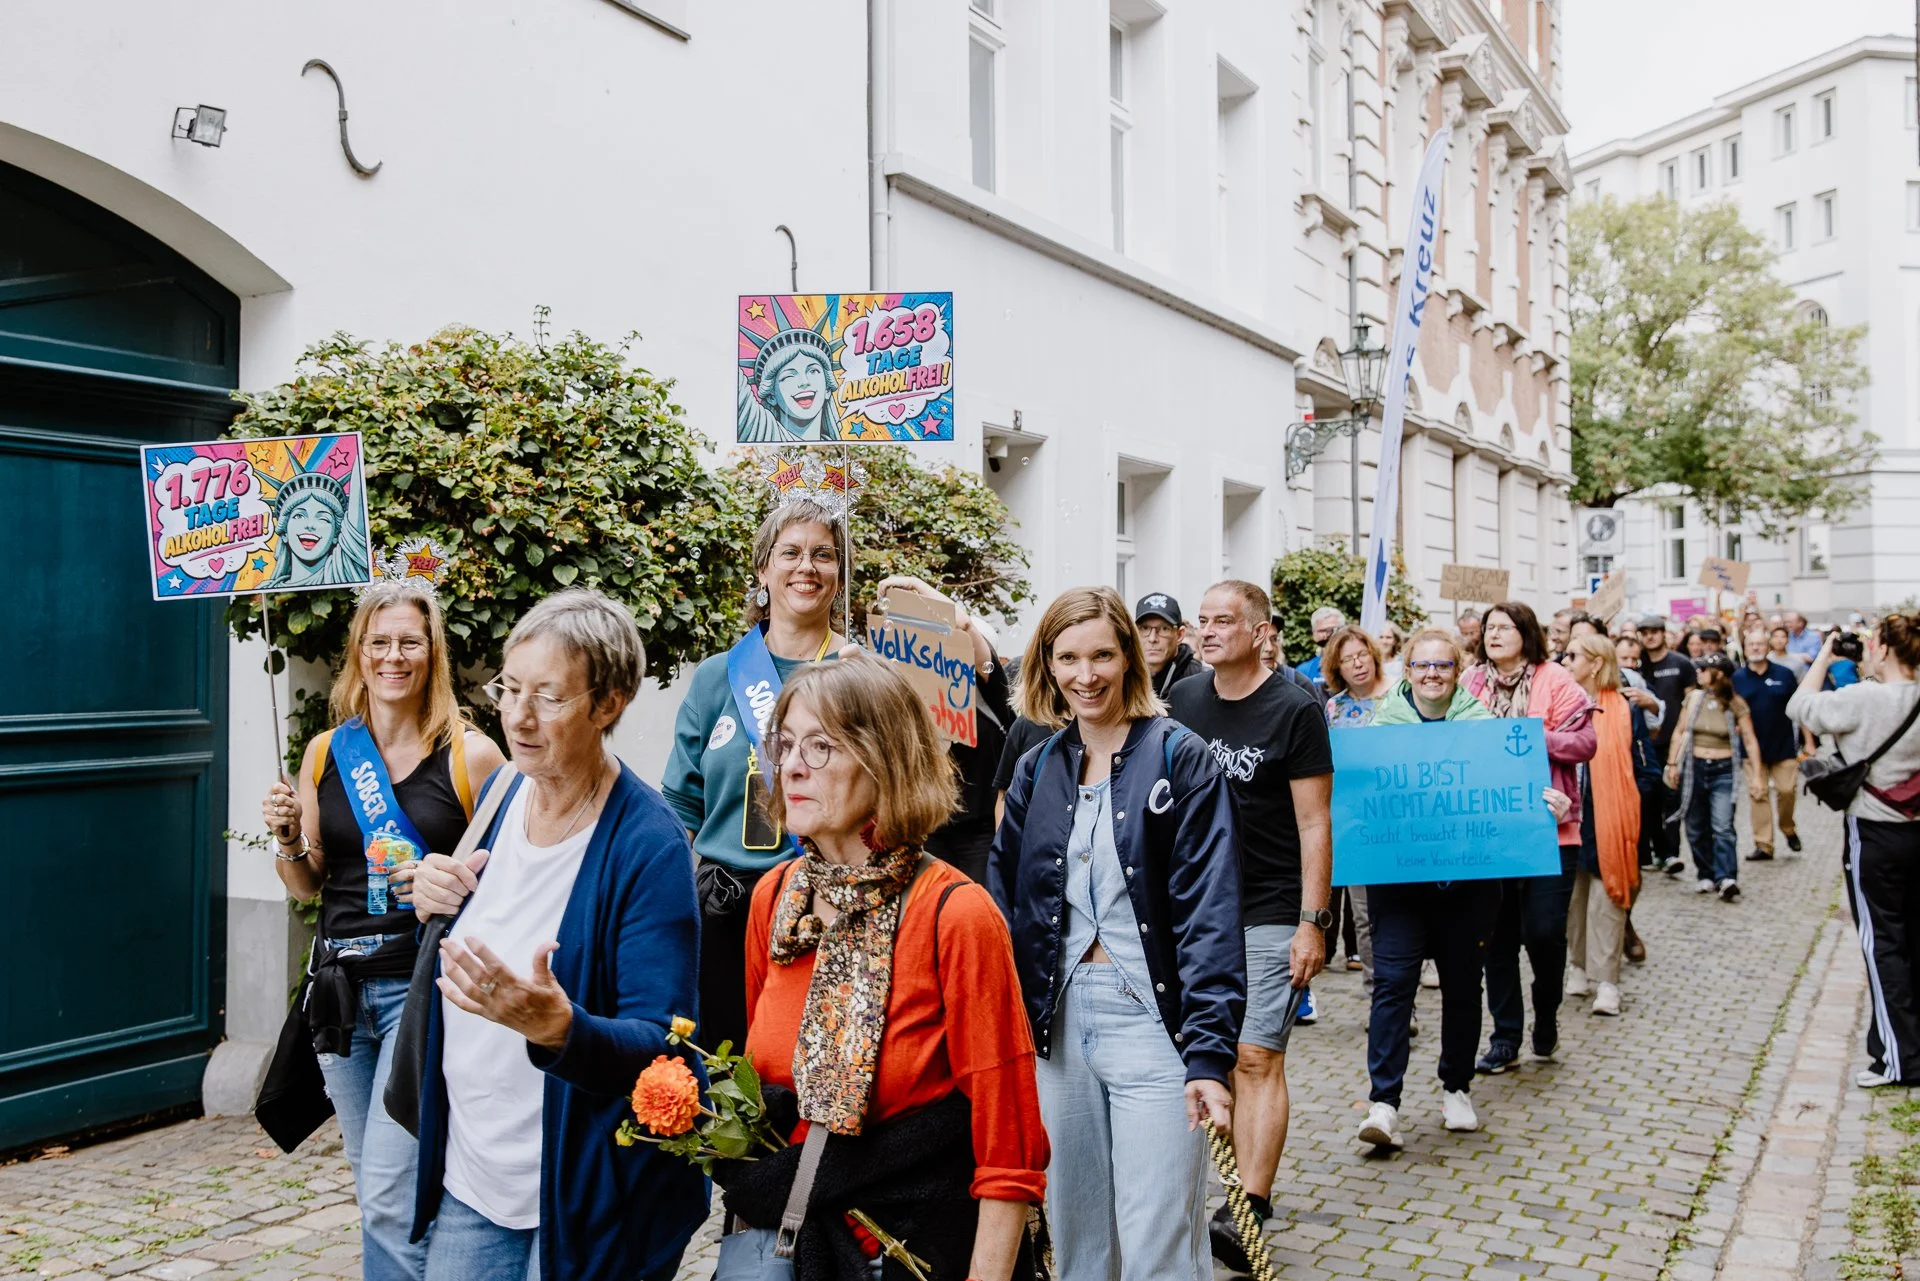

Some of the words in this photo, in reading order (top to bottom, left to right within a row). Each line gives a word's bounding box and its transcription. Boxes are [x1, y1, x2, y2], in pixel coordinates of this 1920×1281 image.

[1408, 185, 1436, 328] Kreuz
[852, 308, 937, 356] 1.658
[866, 345, 923, 376] TAGE
[841, 361, 951, 405] ALKOHOLFREI!
[165, 462, 251, 509] 1.776
[774, 463, 801, 488] FREI!
[184, 497, 240, 530] TAGE
[164, 512, 269, 559] ALKOHOLFREI!
[408, 556, 440, 570] FREI!
[745, 680, 776, 740] SOB
[351, 760, 388, 824] SOBER
[1374, 763, 1408, 792] DU
[1417, 758, 1471, 788] BIST
[1149, 778, 1174, 814] C
[1363, 791, 1428, 820] NICHT
[1359, 824, 1401, 845] Sucht
[1410, 823, 1457, 843] braucht
[1465, 820, 1500, 840] Hilfe
